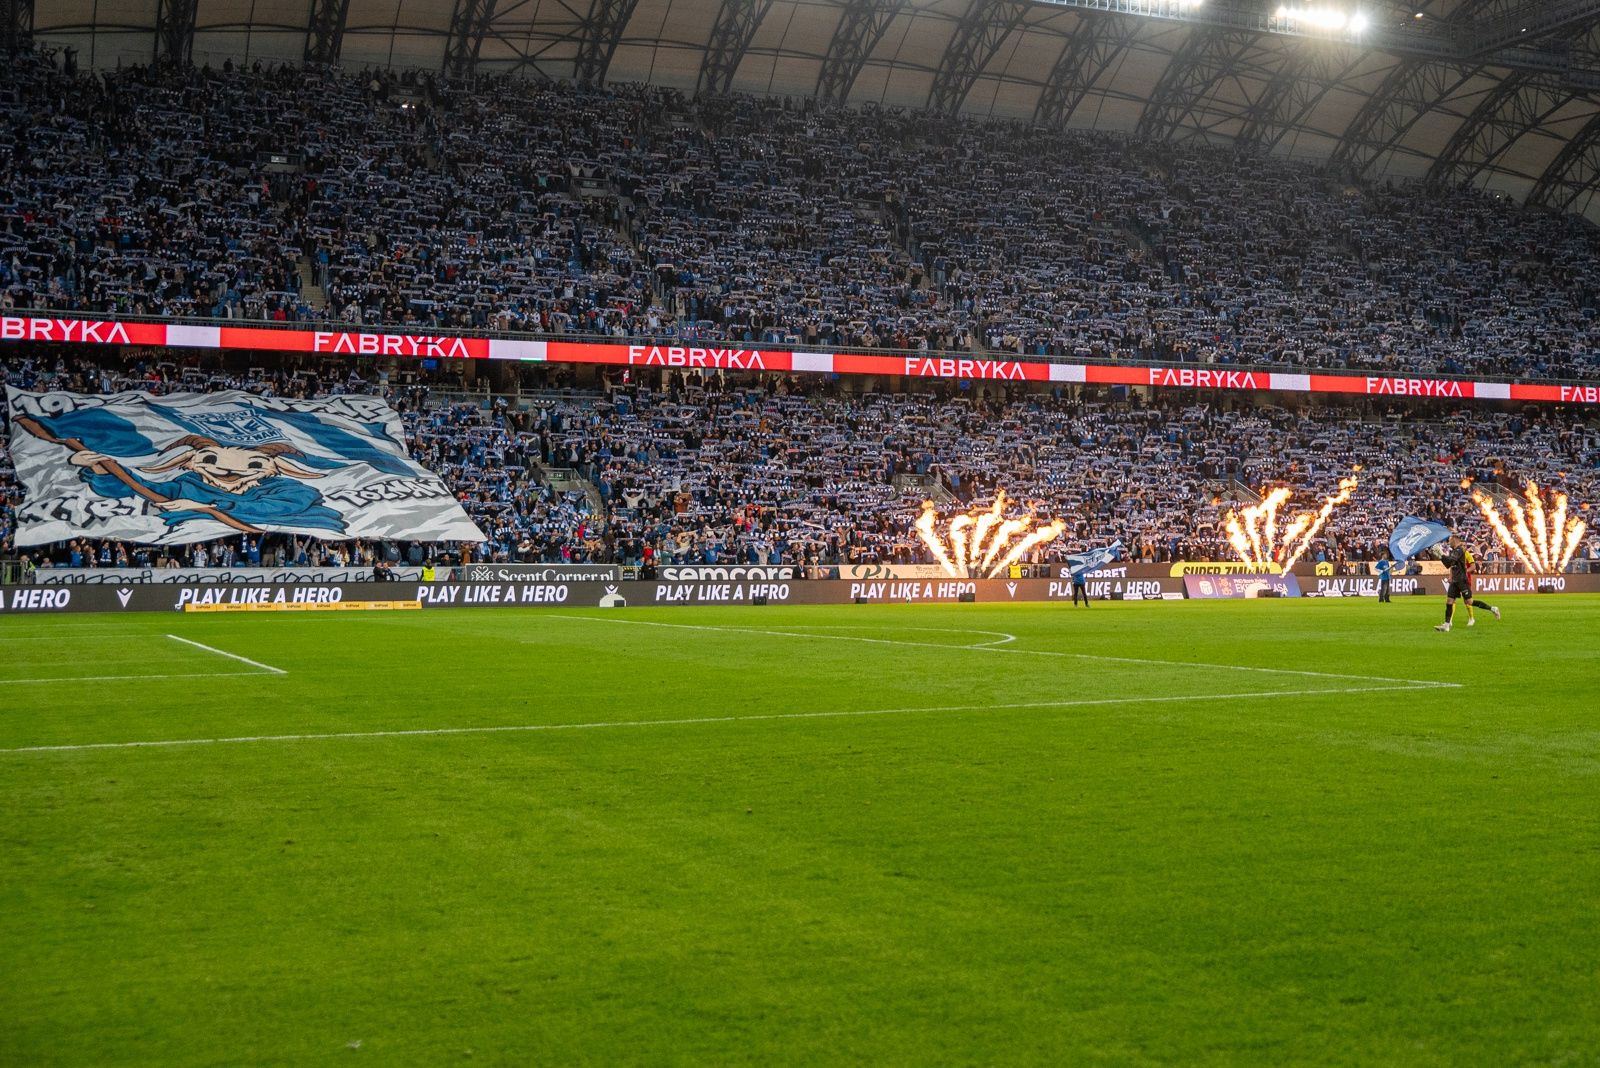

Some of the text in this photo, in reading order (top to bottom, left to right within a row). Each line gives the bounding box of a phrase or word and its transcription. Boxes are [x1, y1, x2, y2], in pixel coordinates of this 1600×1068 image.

[314, 331, 470, 358] FABRYKA
[628, 345, 765, 369] FABRYKA
[905, 358, 1026, 380] FABRYKA
[1149, 368, 1257, 389] FABRYKA
[1366, 377, 1463, 398] FABRYKA
[1561, 386, 1600, 403] FAB
[416, 585, 568, 603] PLAY LIKE A HERO
[655, 584, 790, 601] PLAY LIKE A HERO
[850, 583, 887, 599] PLAY
[890, 582, 921, 599] LIKE
[923, 582, 934, 598] A
[1049, 582, 1073, 597] PLA
[1126, 581, 1161, 596] HERO
[1317, 579, 1347, 593] PLAY
[1349, 579, 1374, 593] LIKE
[1389, 578, 1418, 593] HERO
[1475, 578, 1501, 592] PLAY
[1504, 577, 1526, 591] LIKE
[1527, 577, 1535, 591] A
[11, 588, 71, 609] HERO
[178, 586, 343, 606] PLAY LIKE A HERO
